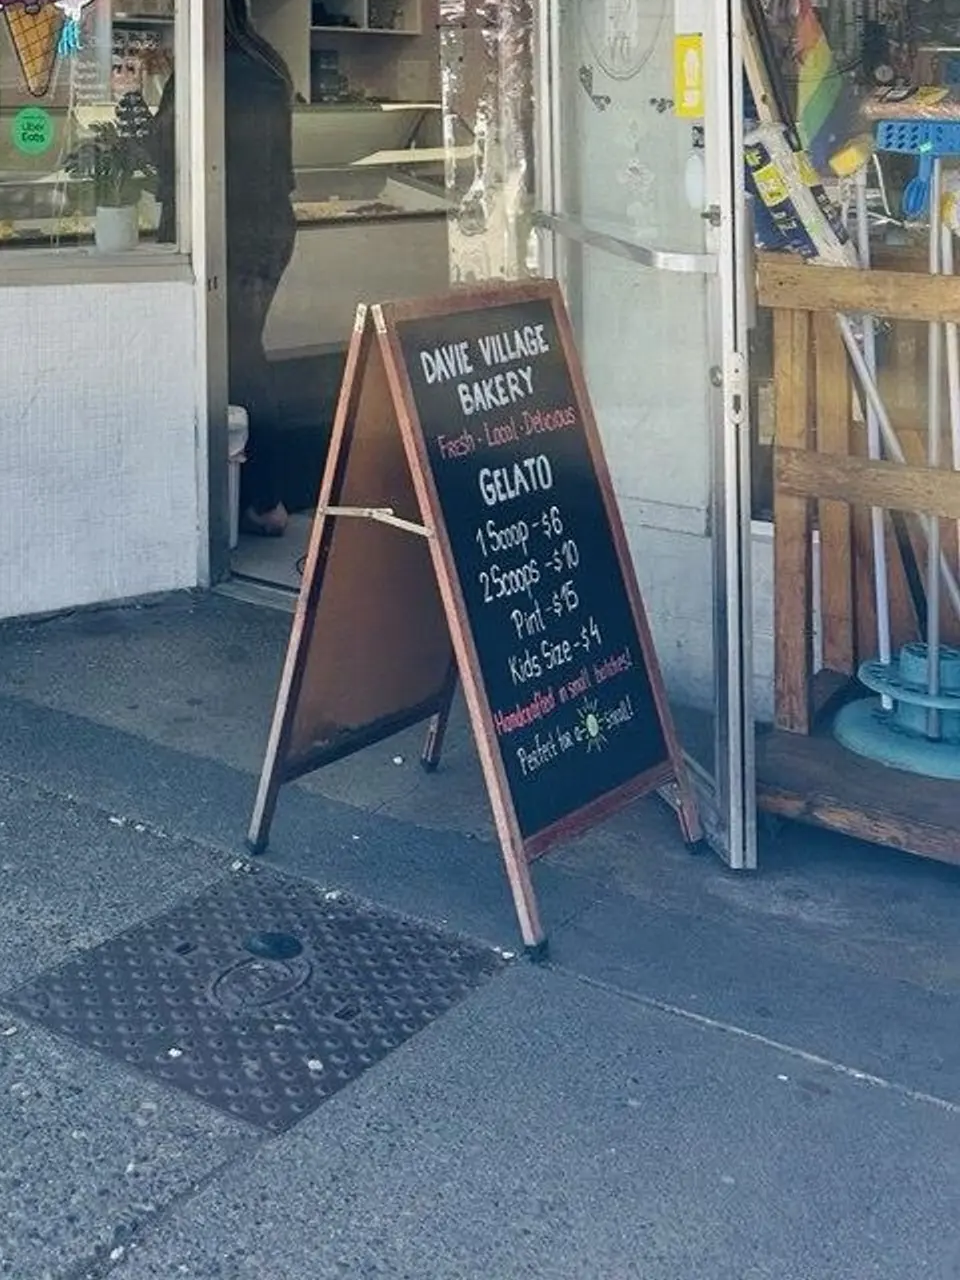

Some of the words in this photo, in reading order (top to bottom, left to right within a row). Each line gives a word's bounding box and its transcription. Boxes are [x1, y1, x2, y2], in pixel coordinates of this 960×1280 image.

[419, 340, 474, 385] DAVIE
[478, 324, 550, 366] VILLAGE
[457, 366, 534, 416] BAKERY
[437, 429, 476, 461] Fresh
[483, 416, 519, 447] Local
[522, 406, 577, 436] Delicious
[479, 454, 554, 506] GELATO
[510, 598, 546, 640] Pint
[508, 649, 541, 686] Kids
[541, 639, 574, 669] Size
[516, 732, 558, 776] Perfect
